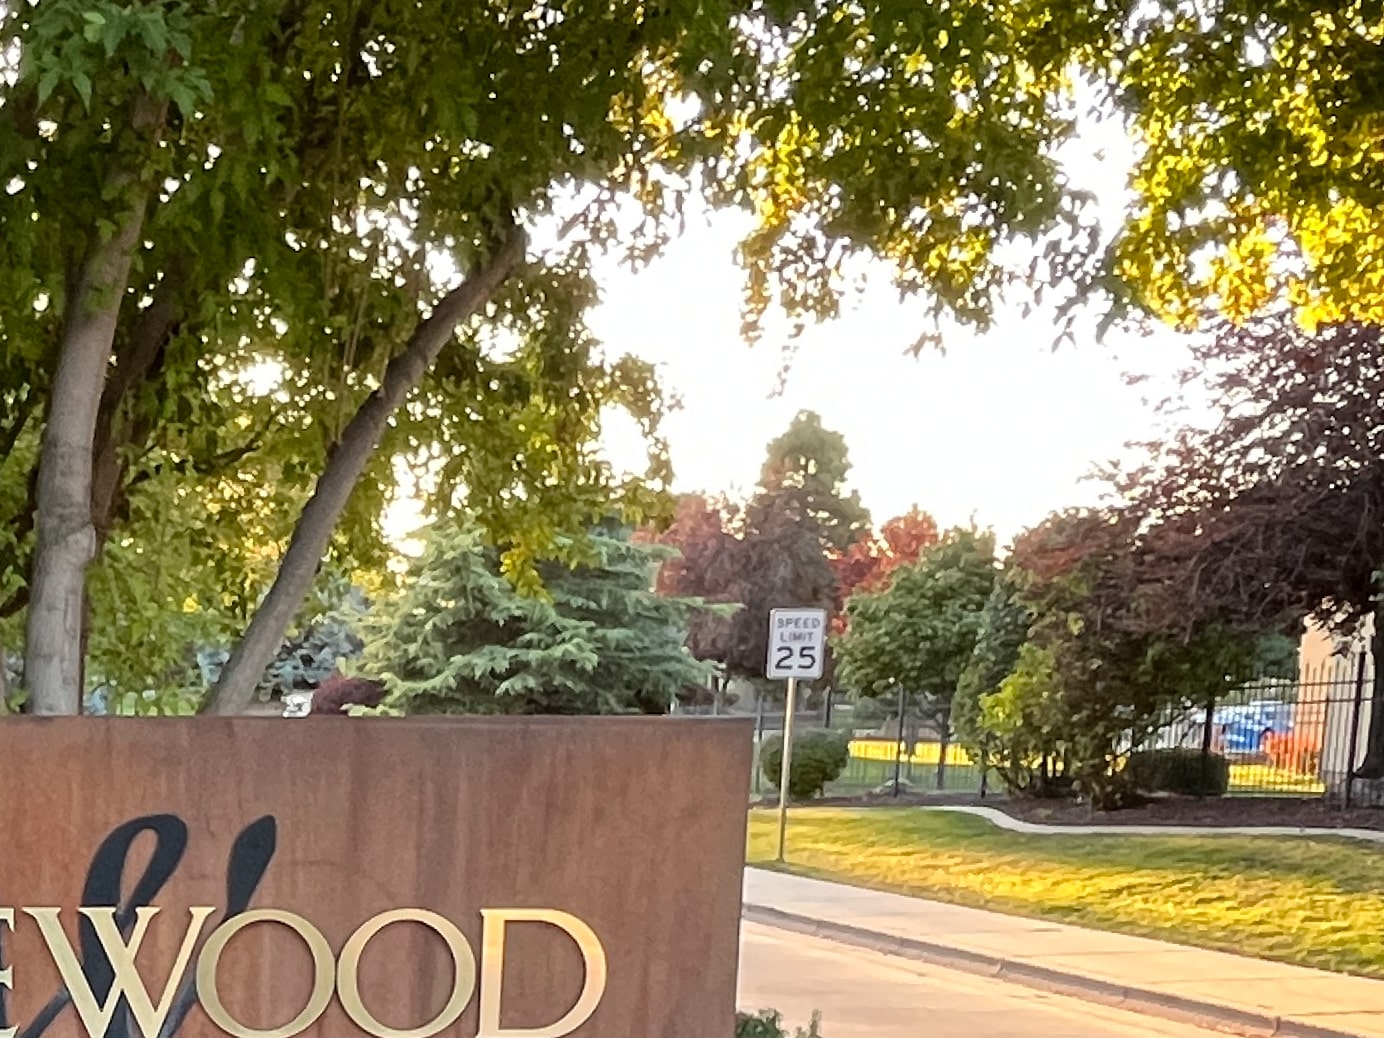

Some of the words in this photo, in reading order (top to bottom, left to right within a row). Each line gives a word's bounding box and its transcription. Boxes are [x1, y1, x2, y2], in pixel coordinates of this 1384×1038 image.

[777, 617, 821, 629] SPEED
[779, 632, 815, 643] LIMIT
[775, 646, 816, 669] 25
